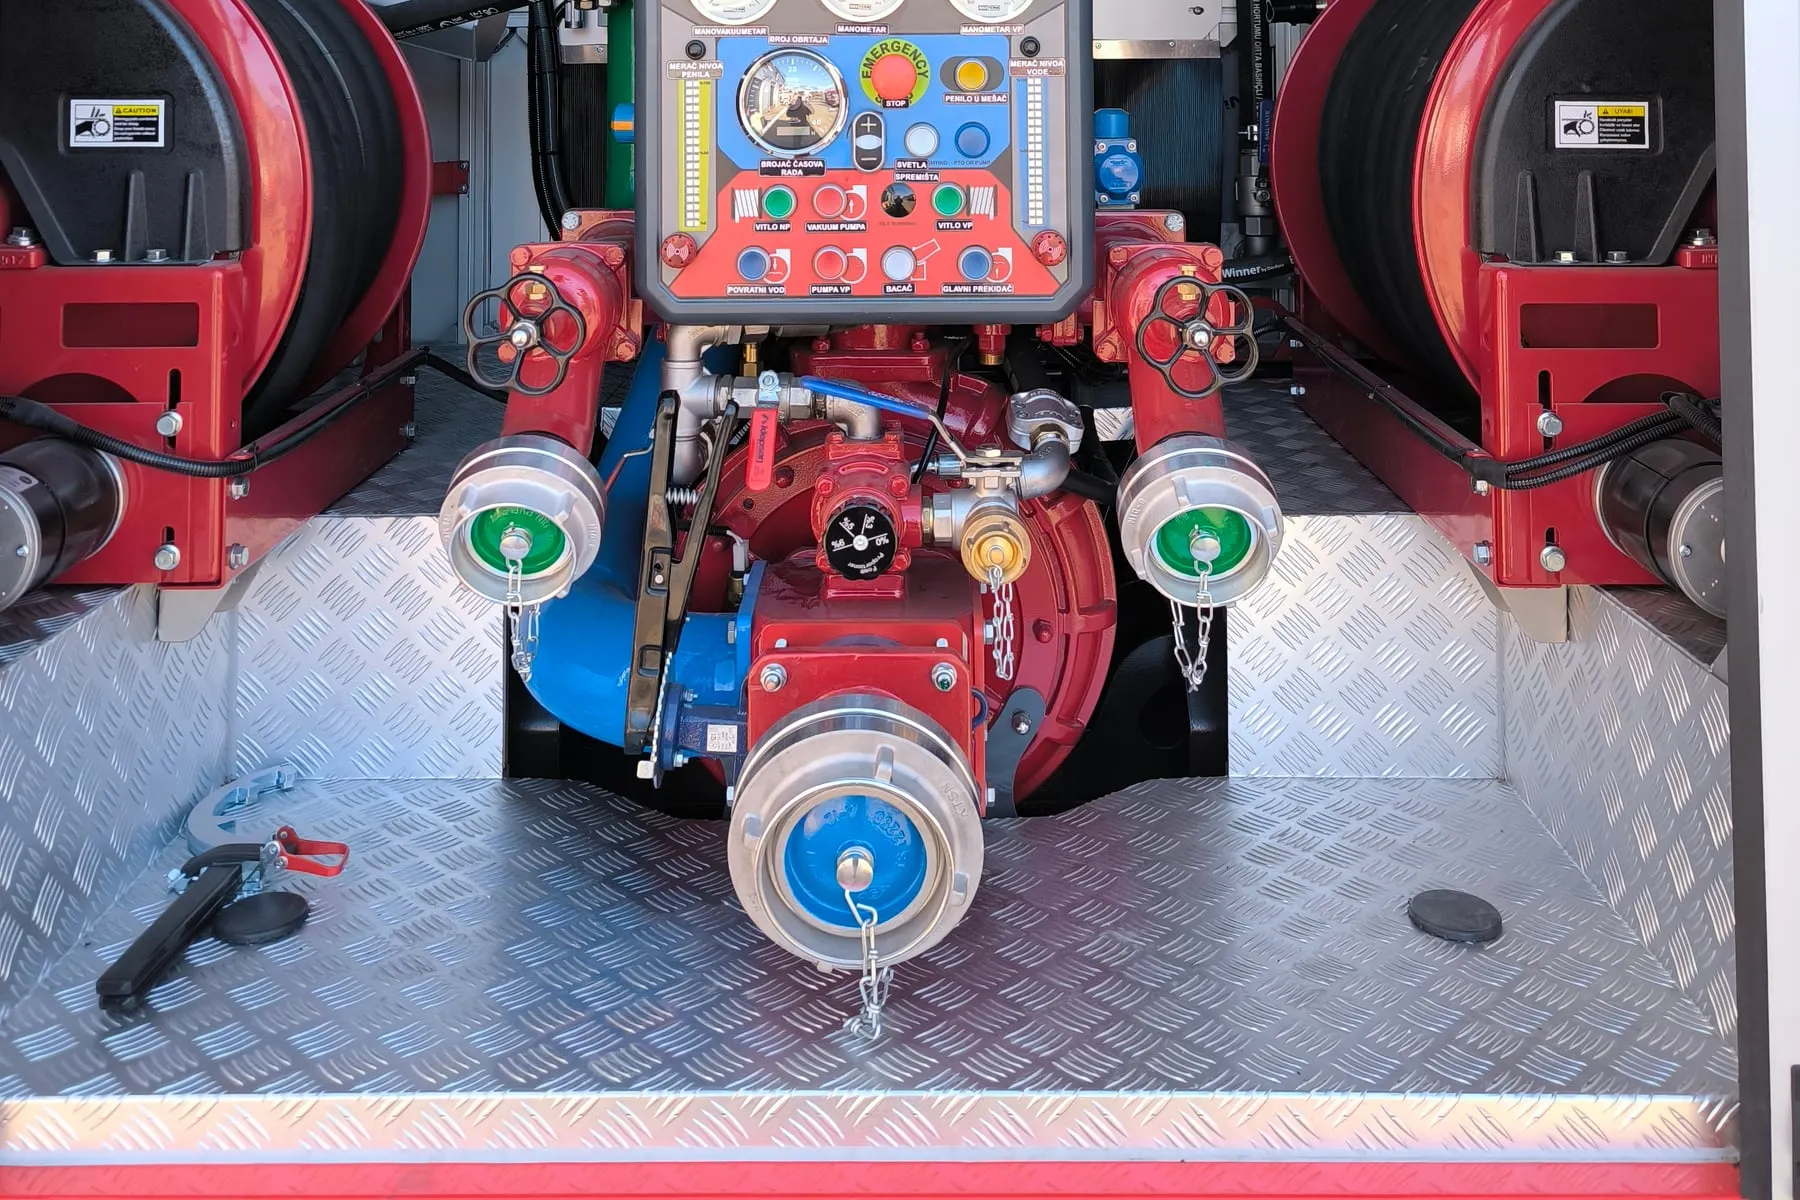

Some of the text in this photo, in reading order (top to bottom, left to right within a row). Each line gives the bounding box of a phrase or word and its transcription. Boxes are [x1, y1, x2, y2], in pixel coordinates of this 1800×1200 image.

[1253, 3, 1261, 39] HORTUMU
[1254, 41, 1262, 60] ORTA
[862, 40, 929, 79] EMERGENCY
[1011, 59, 1038, 67] MERAČ
[669, 61, 723, 70] MERAČ NIVOA
[895, 172, 939, 180] SPREMIŠTA
[1222, 266, 1260, 278] Winner
[886, 284, 912, 292] BACAČ
[973, 284, 1012, 292] PREKIDAČ
